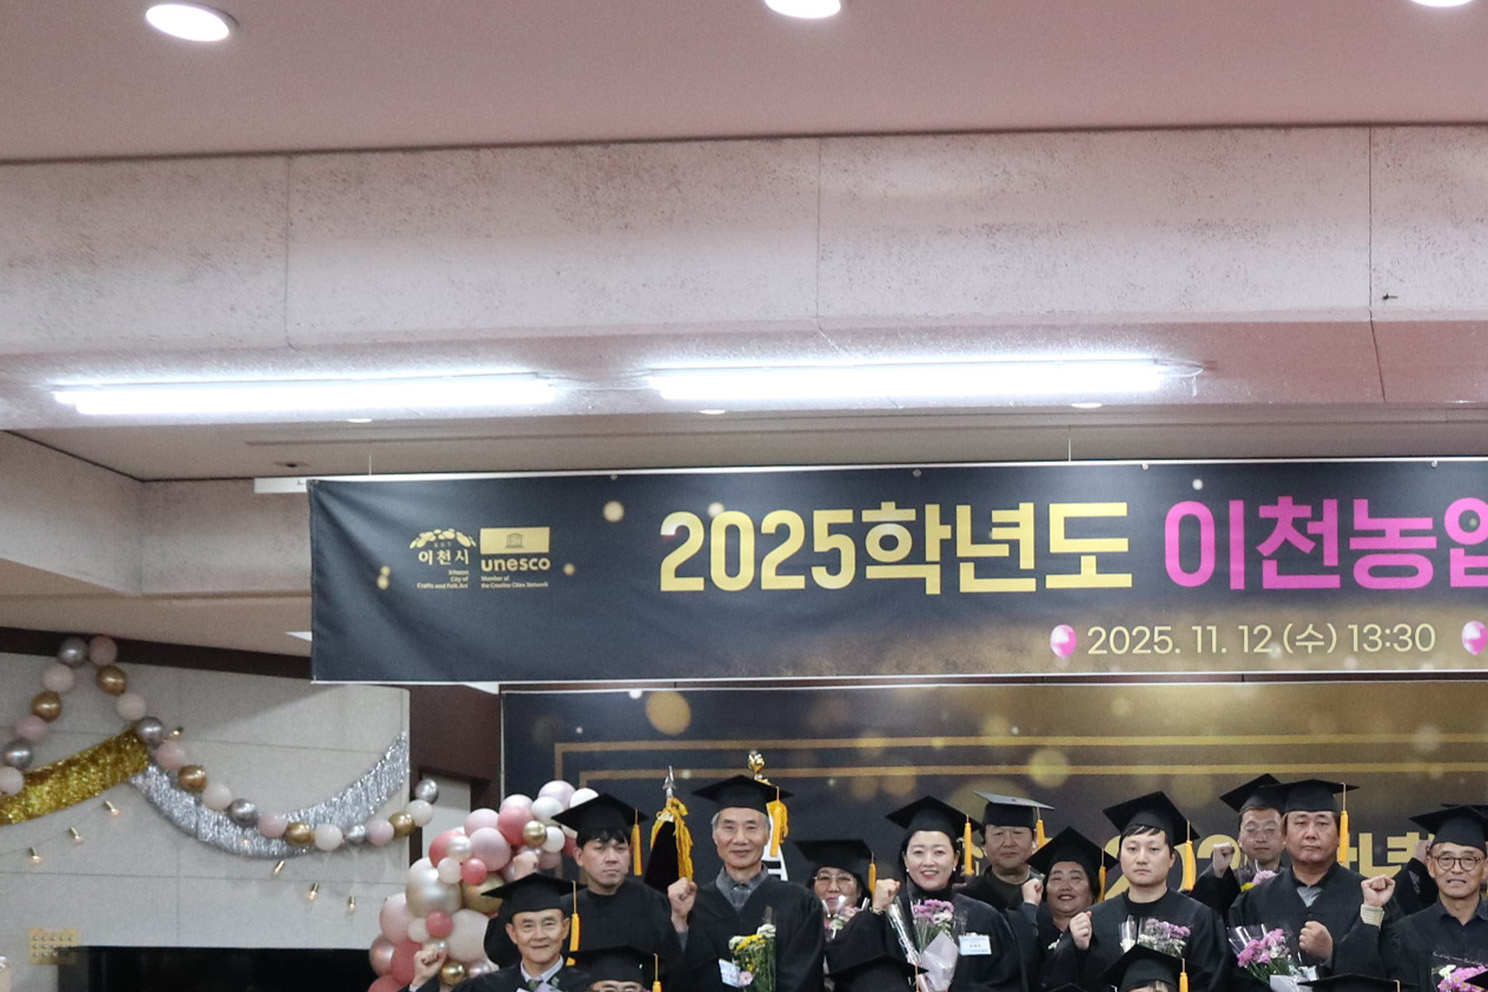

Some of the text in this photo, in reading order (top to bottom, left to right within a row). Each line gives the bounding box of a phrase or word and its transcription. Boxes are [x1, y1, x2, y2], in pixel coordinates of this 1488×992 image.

[418, 549, 469, 566] 이천시
[660, 501, 1133, 595] 2025학년도
[481, 557, 550, 572] unesco
[1087, 625, 1181, 655] 2025.
[1192, 625, 1228, 654] 11.
[1347, 623, 1436, 653] 13:30
